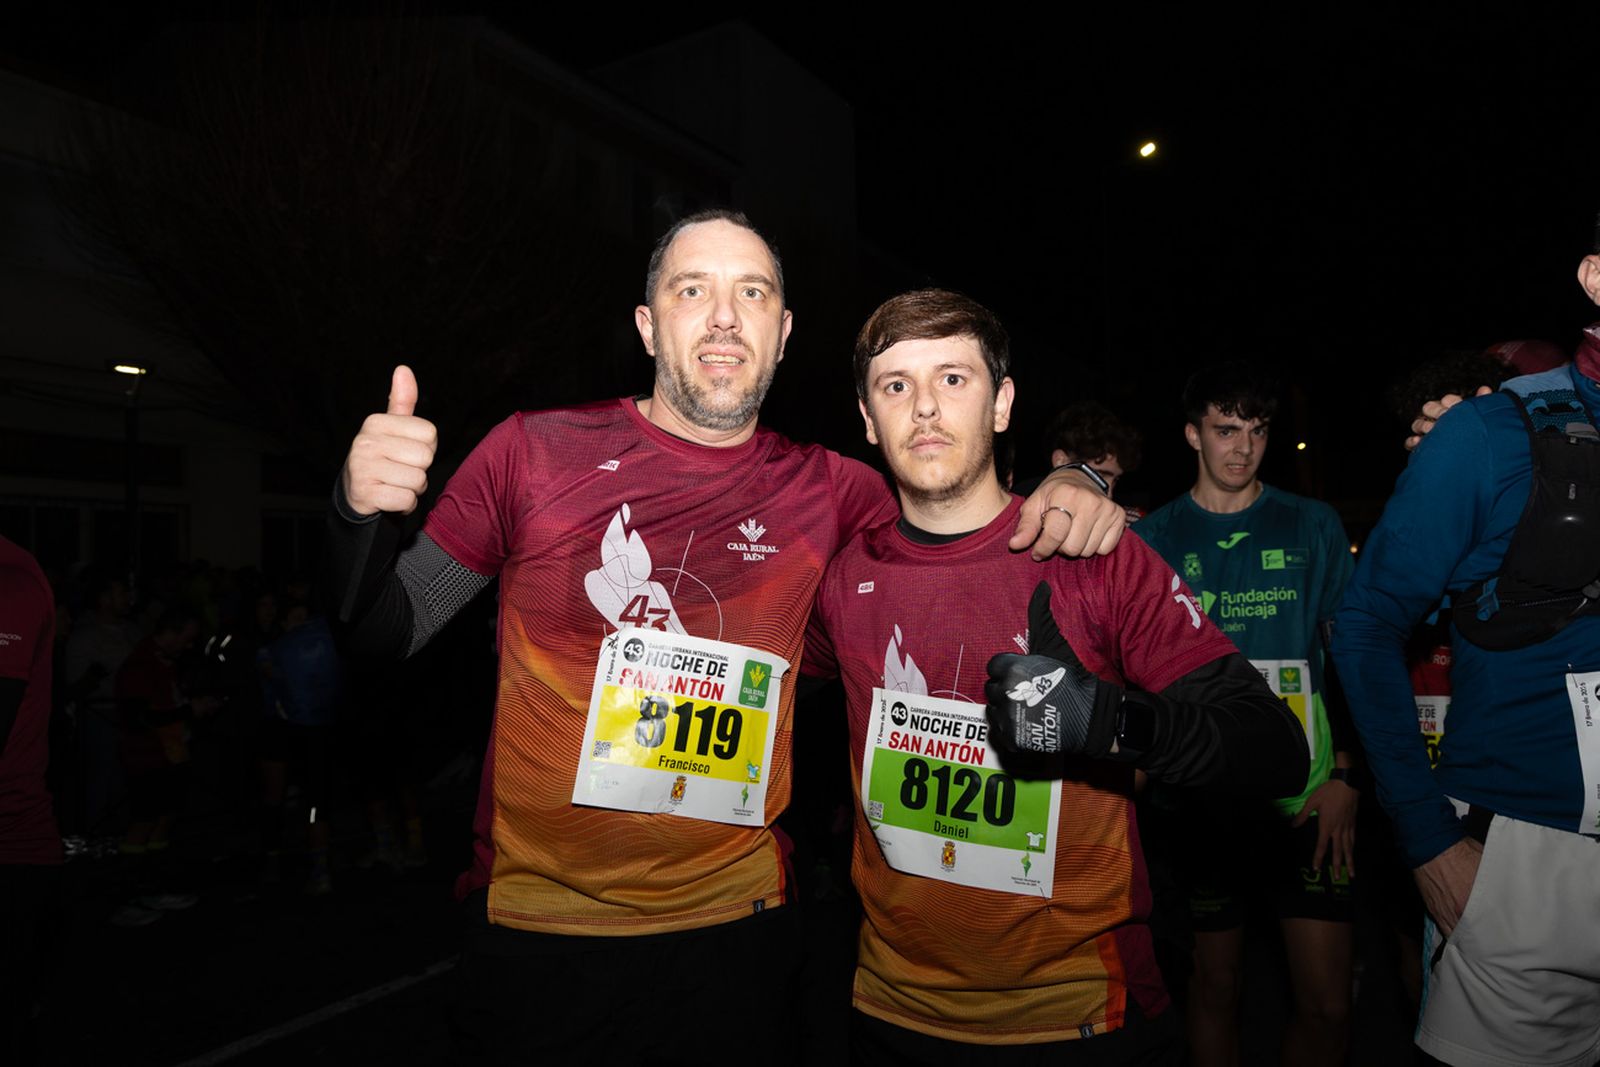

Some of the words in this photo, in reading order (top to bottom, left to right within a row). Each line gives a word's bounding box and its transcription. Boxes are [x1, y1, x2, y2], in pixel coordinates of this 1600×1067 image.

[727, 542, 749, 551] CAJA
[750, 544, 779, 553] RURAL
[1221, 587, 1297, 604] Fundación
[1221, 602, 1277, 619] Unicaja
[624, 642, 643, 656] 43
[645, 651, 703, 673] NOCHE
[706, 660, 728, 678] DE
[660, 674, 725, 701] ANTÓN
[1036, 677, 1053, 695] 43
[891, 706, 906, 720] 43
[910, 707, 930, 715] CARRERA
[635, 695, 743, 761] 8119
[910, 714, 962, 738] NOCHE
[965, 724, 988, 742] DE
[1031, 722, 1044, 752] SAN
[1040, 703, 1057, 753] ANTÓN
[888, 731, 923, 753] SAN
[924, 737, 985, 765] ANTÓN
[658, 755, 710, 775] Francisco
[900, 757, 1016, 827] 8120
[934, 820, 969, 839] Daniel
